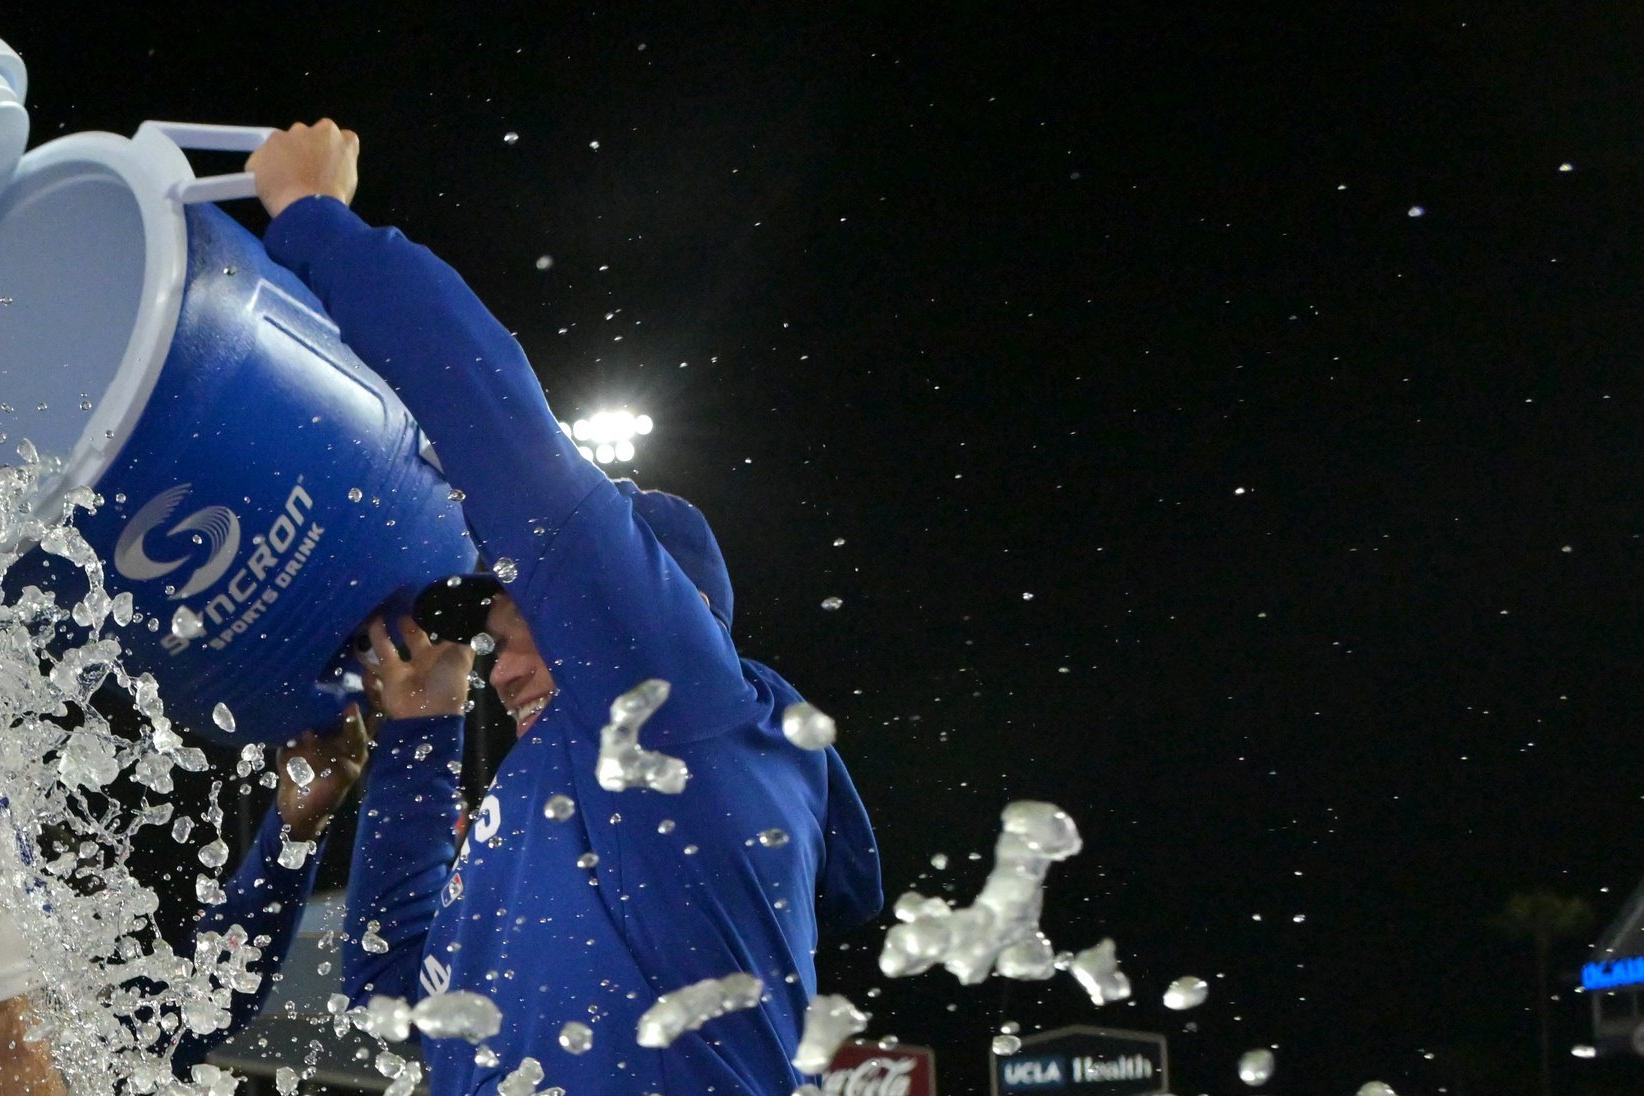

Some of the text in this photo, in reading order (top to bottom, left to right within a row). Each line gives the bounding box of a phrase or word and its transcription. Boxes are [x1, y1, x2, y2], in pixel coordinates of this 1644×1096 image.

[209, 521, 325, 650] SPORTS DRINK
[1003, 1054, 1154, 1086] UCLA Health
